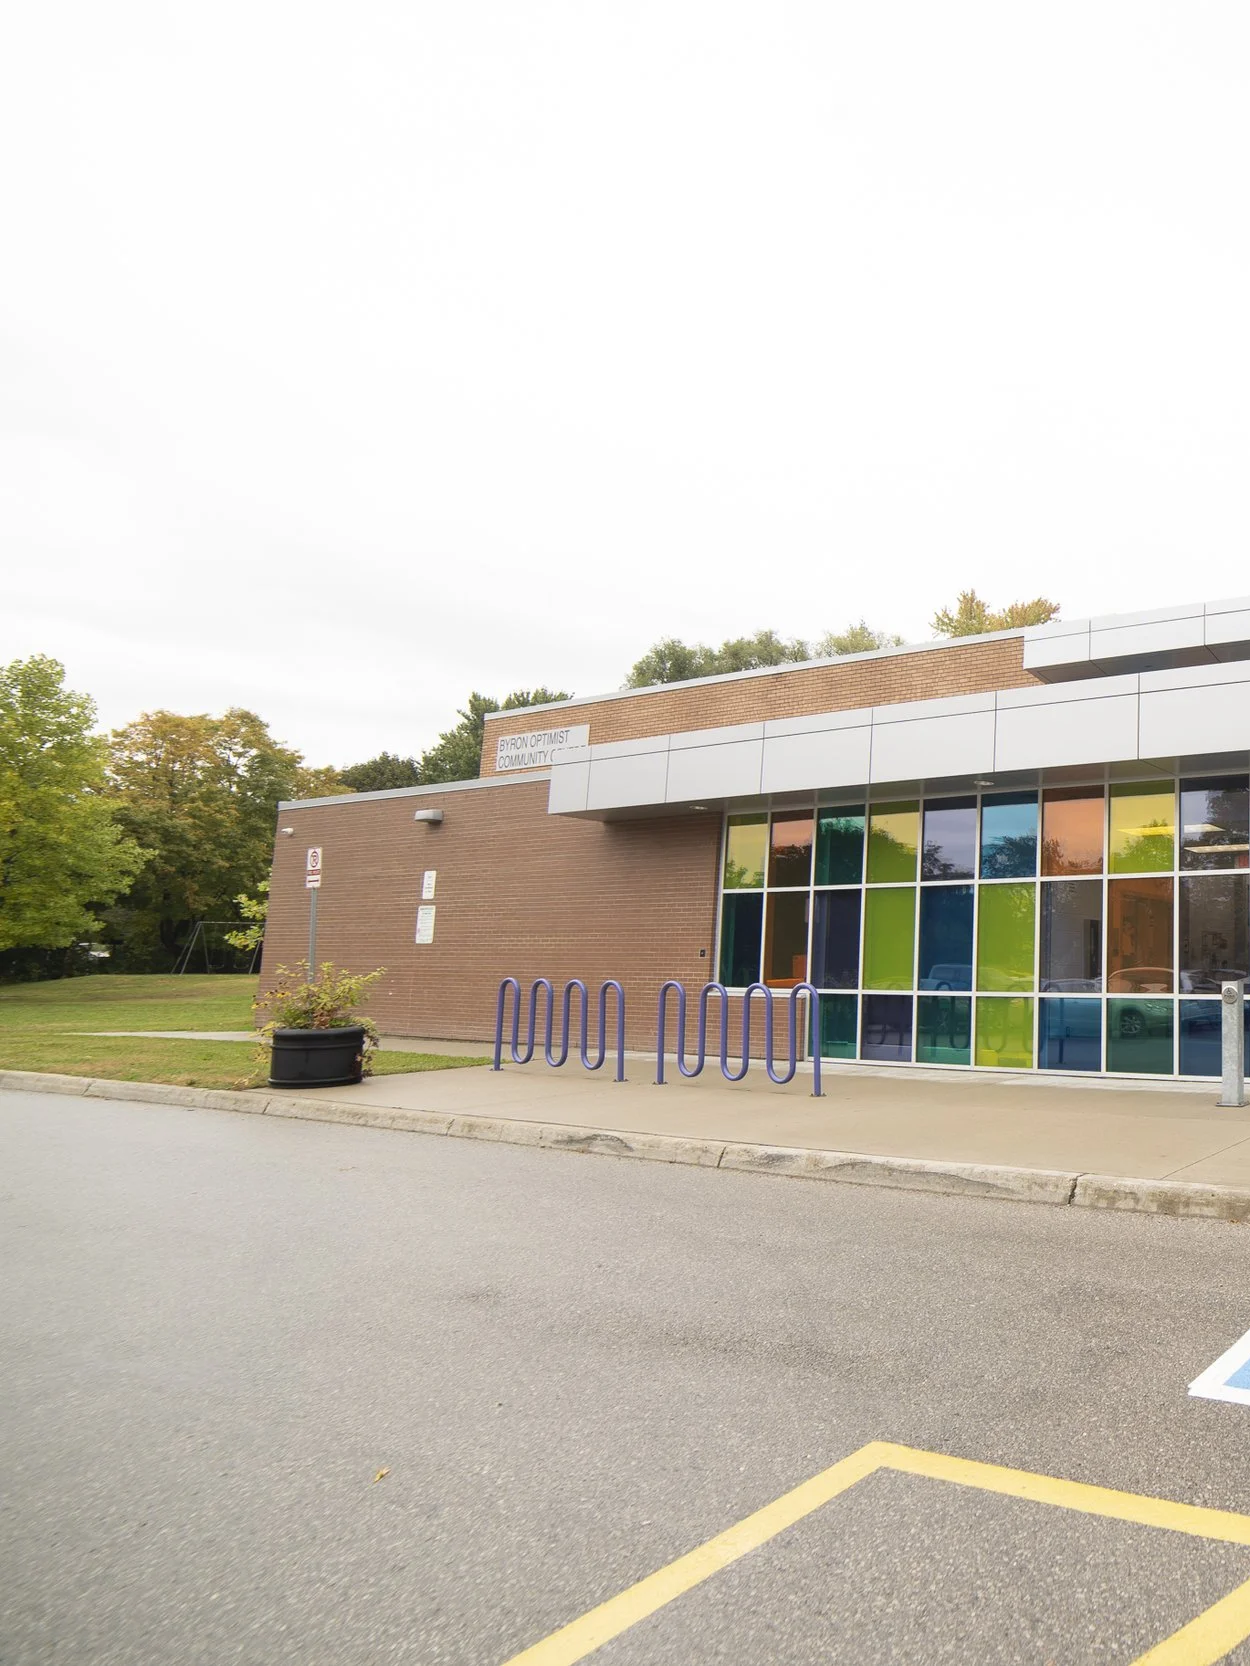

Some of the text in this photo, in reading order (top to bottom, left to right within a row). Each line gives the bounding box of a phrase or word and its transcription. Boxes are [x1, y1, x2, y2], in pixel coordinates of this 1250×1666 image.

[499, 730, 570, 752] BYRON OPTIMIST
[498, 750, 549, 769] COMMUNITY
